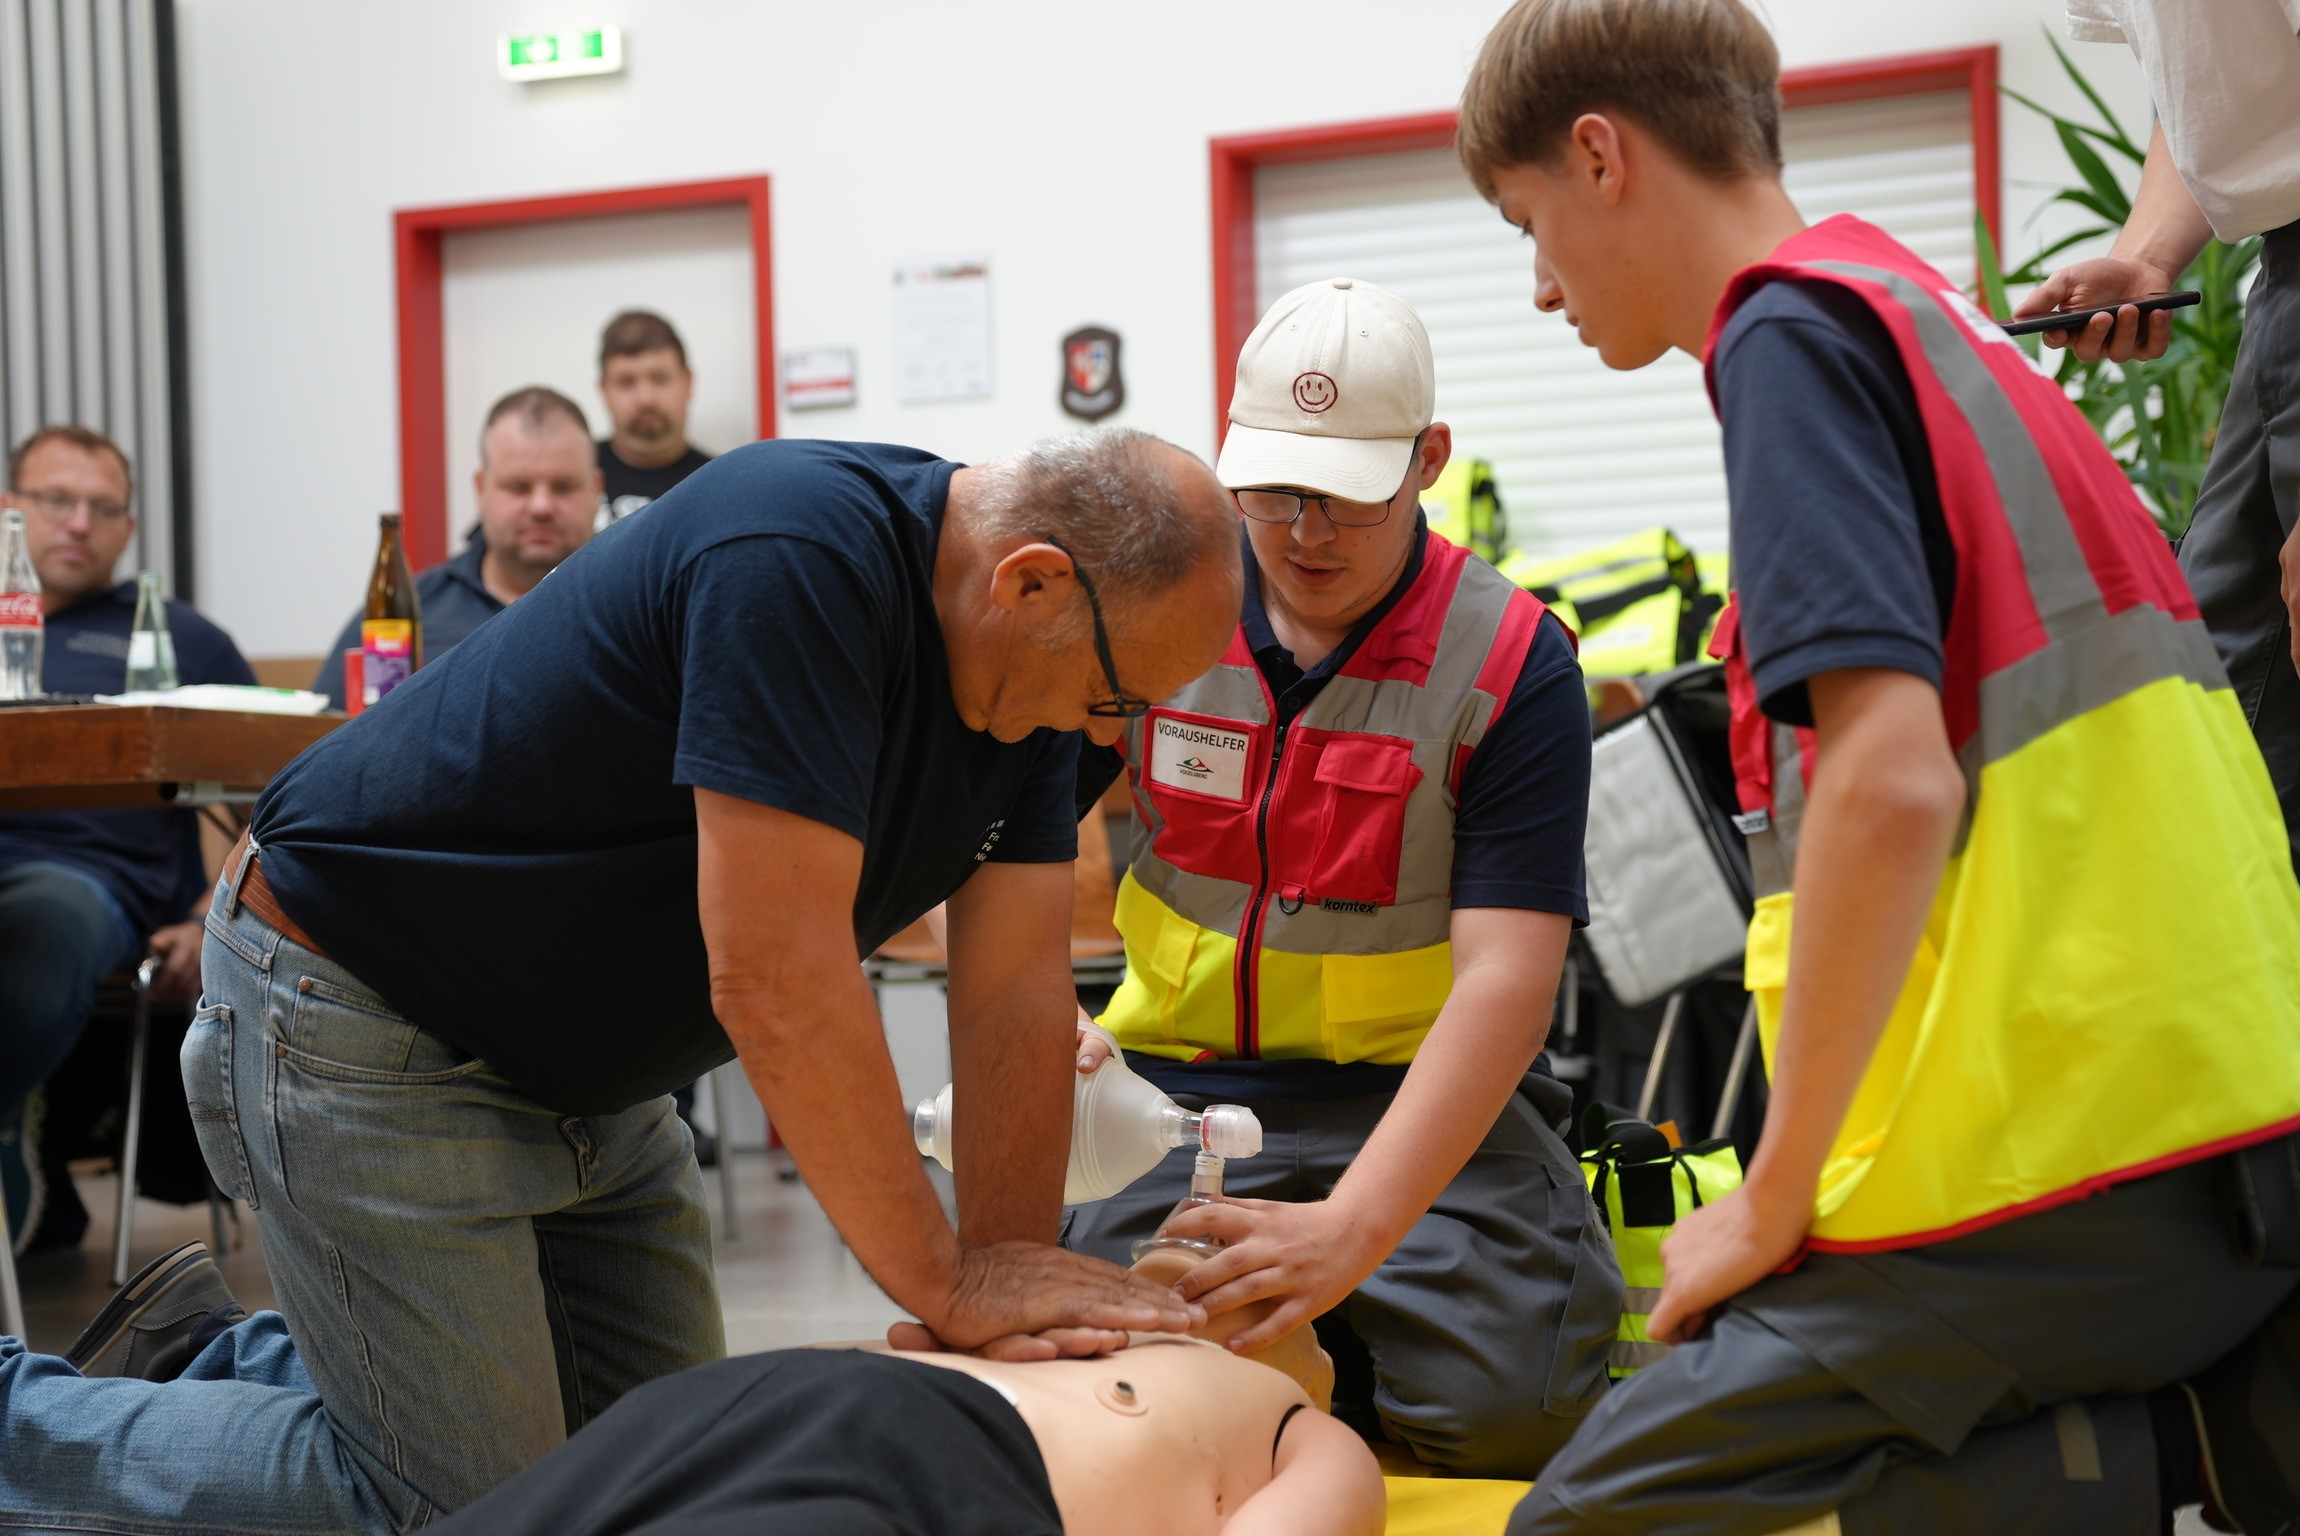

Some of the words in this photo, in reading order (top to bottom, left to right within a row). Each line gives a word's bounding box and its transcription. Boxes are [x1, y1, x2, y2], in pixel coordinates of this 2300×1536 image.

[1158, 722, 1245, 751] VORAUSHELFER
[1179, 768, 1208, 780] VOGELSBERG
[1324, 898, 1377, 914] korntex
